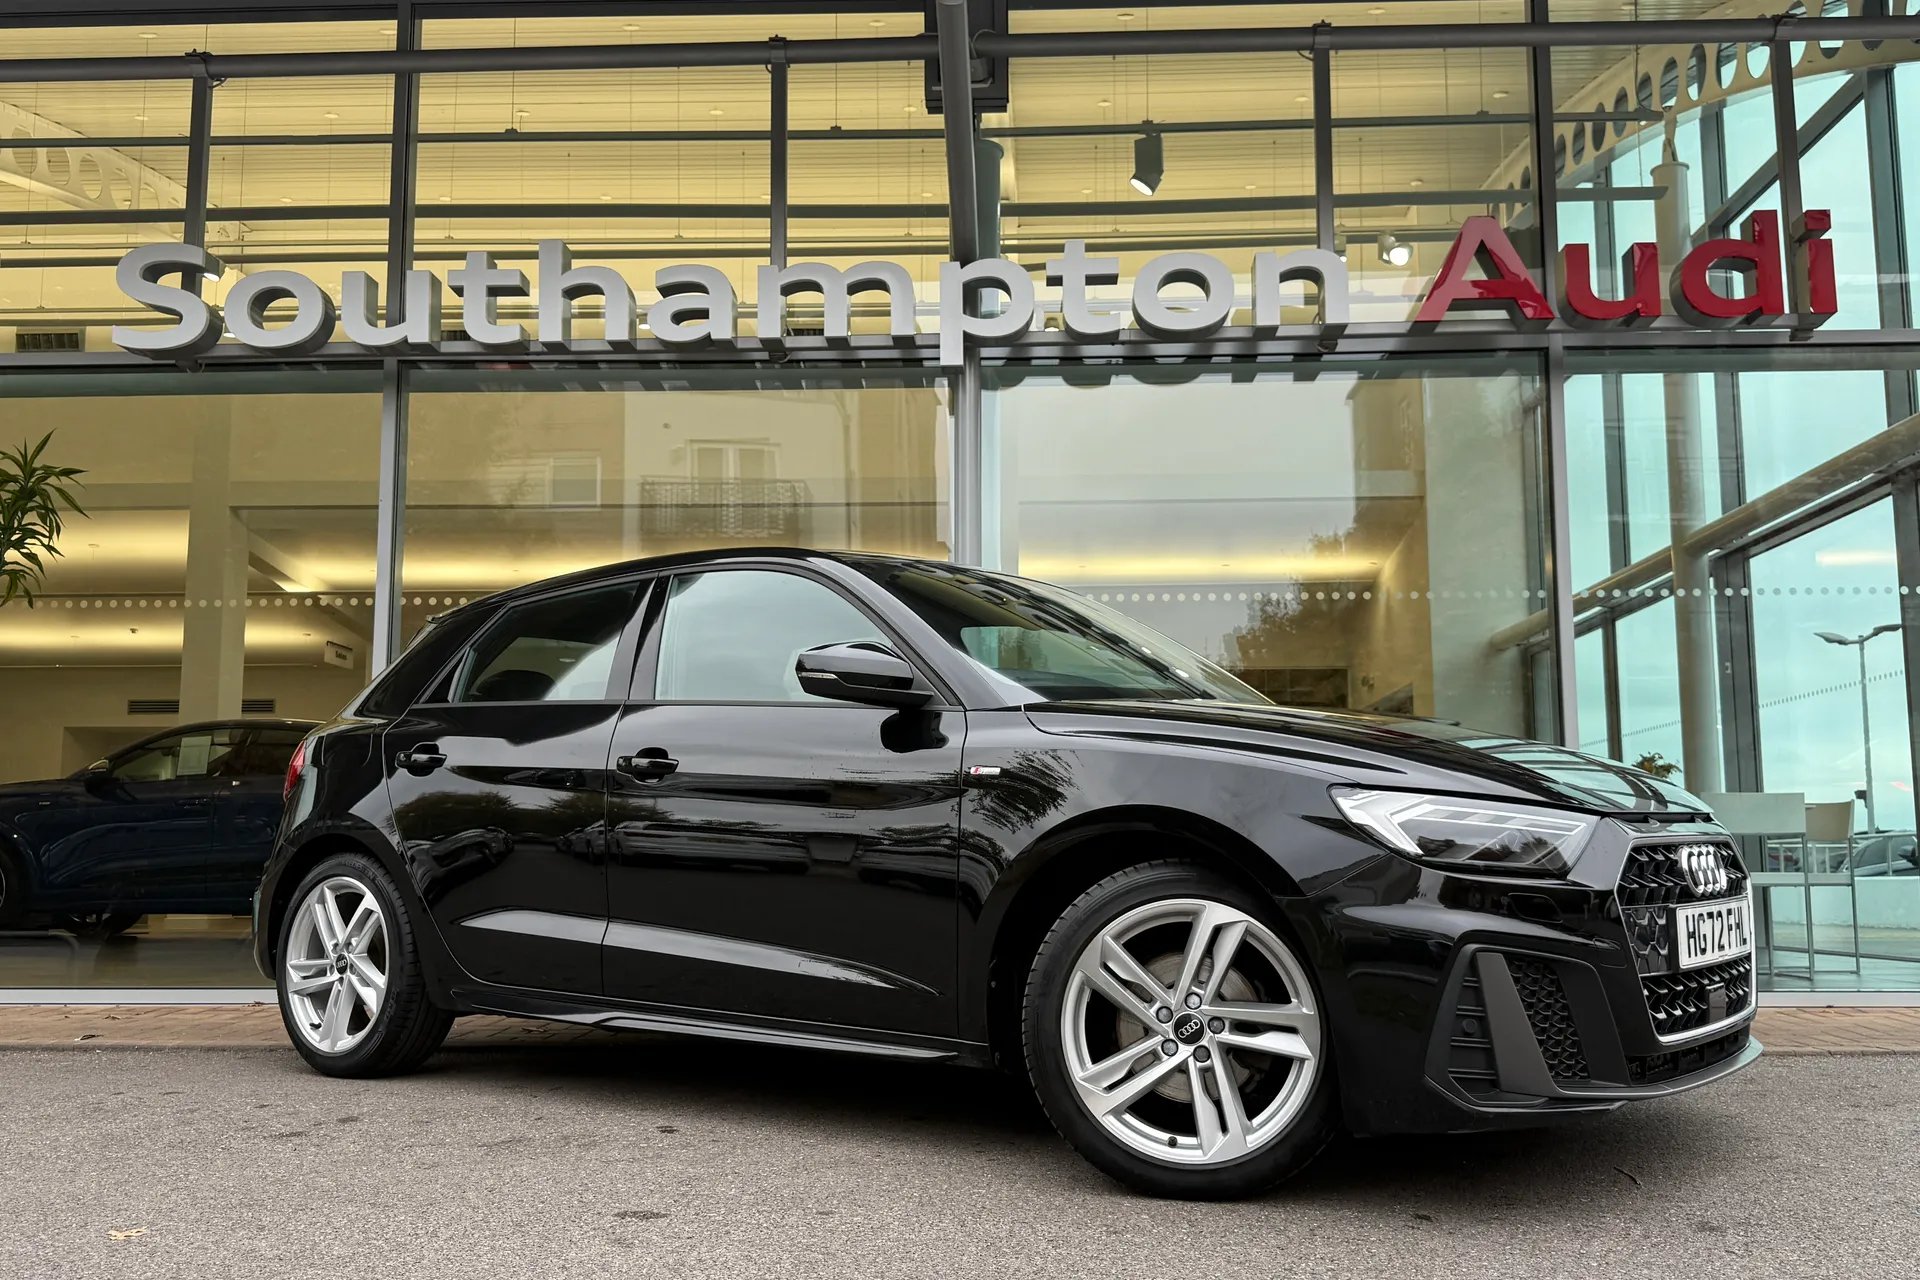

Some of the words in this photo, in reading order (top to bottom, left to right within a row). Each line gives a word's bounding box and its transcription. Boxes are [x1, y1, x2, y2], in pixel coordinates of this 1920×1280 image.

[112, 239, 1349, 367] Southampton
[1411, 209, 1838, 327] Audi
[1686, 910, 1725, 958] HG72
[1726, 906, 1748, 950] FHL
